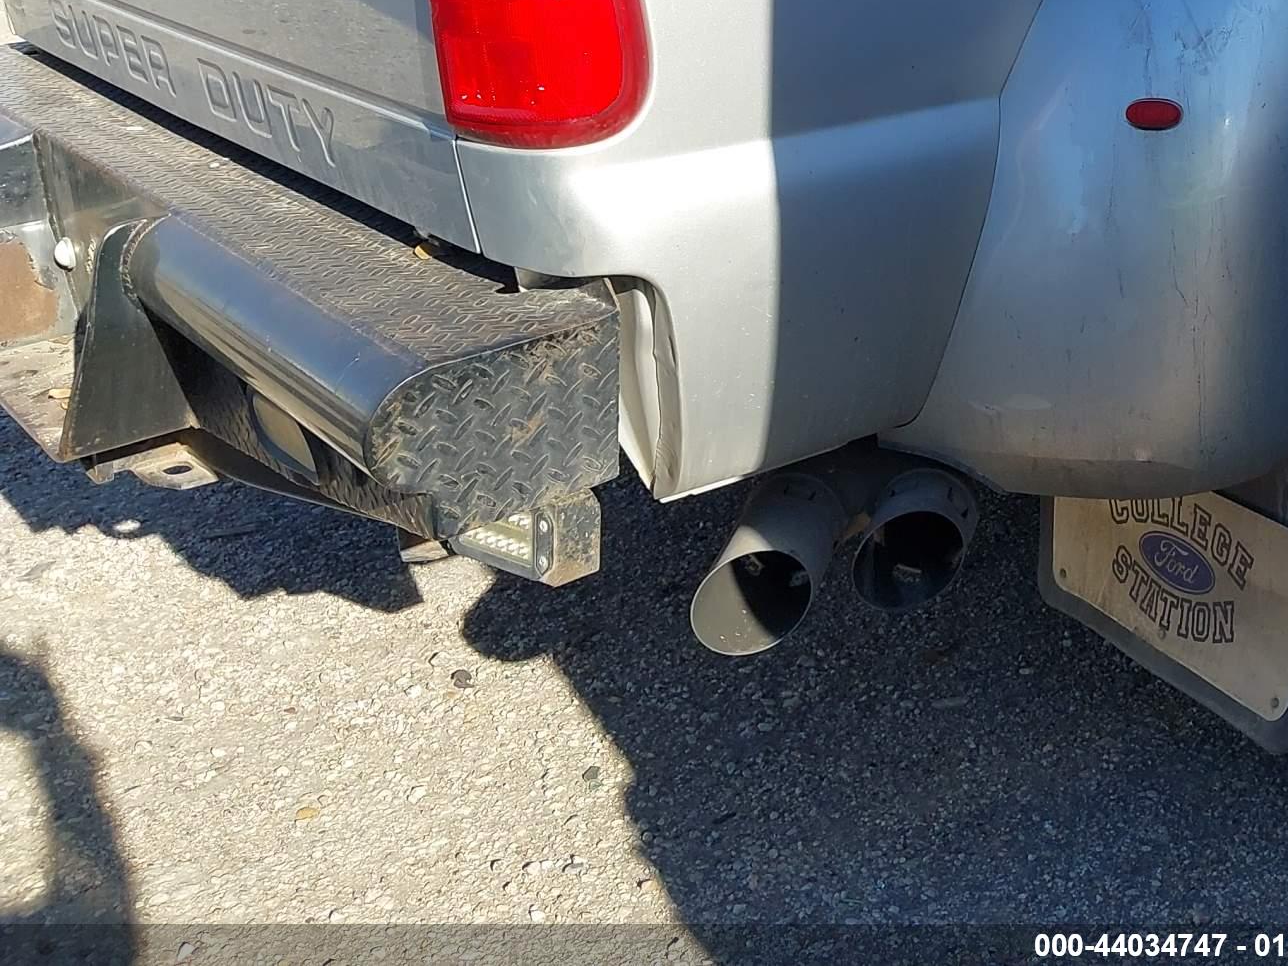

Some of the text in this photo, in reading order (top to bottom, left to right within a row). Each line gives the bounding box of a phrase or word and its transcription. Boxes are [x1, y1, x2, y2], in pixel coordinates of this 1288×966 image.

[197, 57, 337, 168] DUTY
[1109, 496, 1255, 591] COLLEGE
[1154, 539, 1199, 584] Ford
[1112, 545, 1235, 644] STATION
